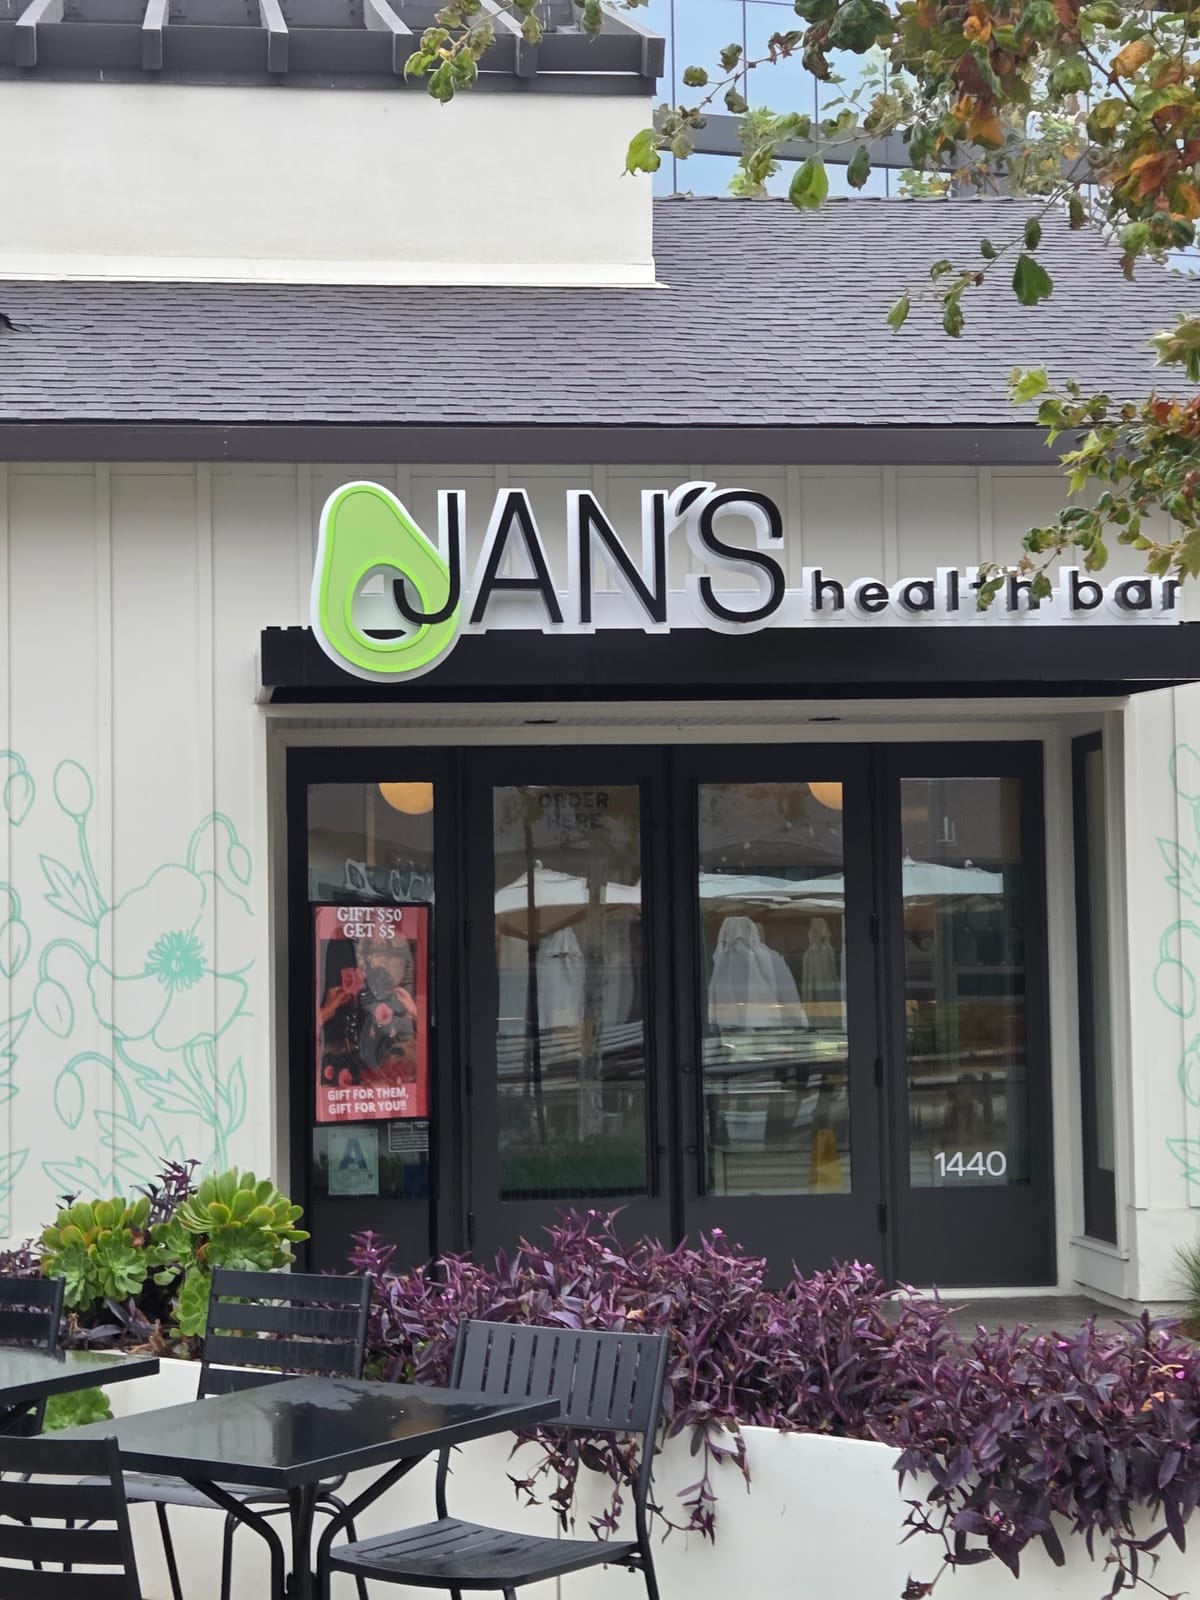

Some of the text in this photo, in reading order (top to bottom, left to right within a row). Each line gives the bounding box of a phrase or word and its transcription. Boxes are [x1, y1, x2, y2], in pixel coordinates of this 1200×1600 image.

[393, 485, 786, 625] JAN'S
[1068, 569, 1181, 612] bar
[337, 907, 402, 923] GIFT $50
[343, 923, 396, 939] GET $5
[328, 1086, 409, 1101] GIFT FOR THEM,
[328, 1103, 352, 1115] GIFT
[354, 1102, 377, 1113] FOR
[339, 1136, 369, 1170] A
[934, 1150, 1007, 1177] 1440
